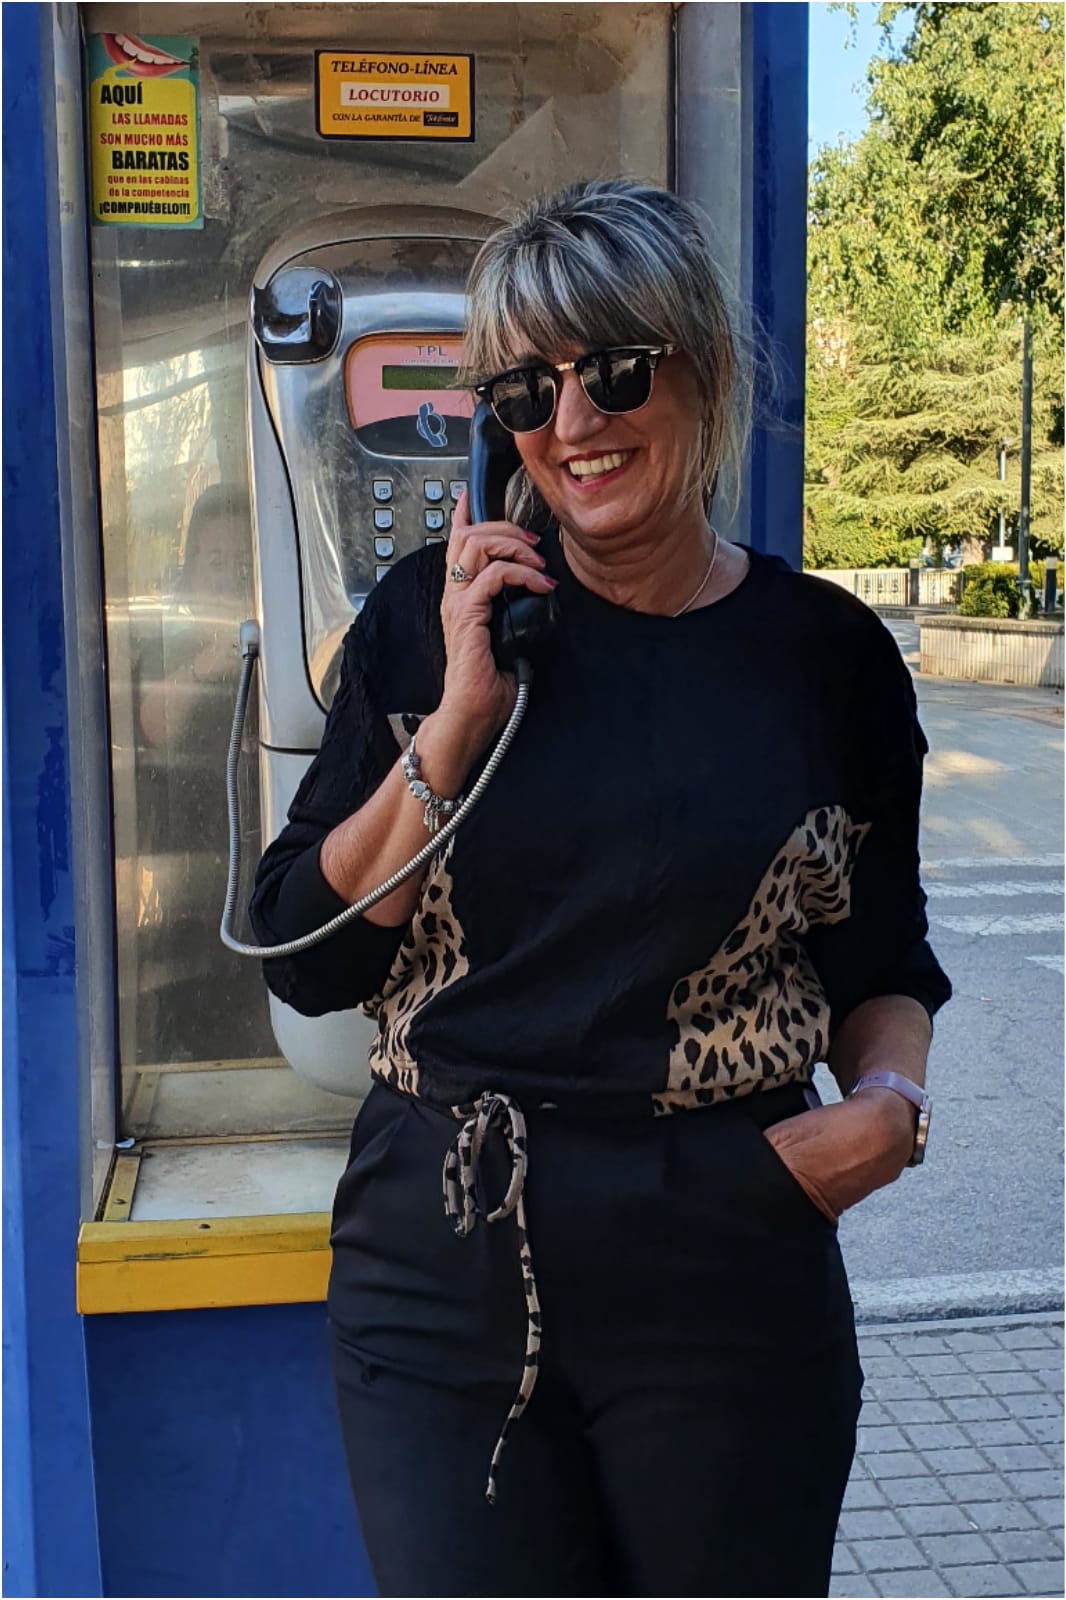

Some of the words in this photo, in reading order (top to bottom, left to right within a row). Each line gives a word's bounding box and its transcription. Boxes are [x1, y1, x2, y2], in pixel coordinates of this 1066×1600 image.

[331, 59, 458, 75] TELÉFONO-LÍNEA
[100, 82, 143, 106] AQUÍ
[349, 89, 440, 102] LOCUTORIO
[112, 113, 131, 125] LAS
[134, 113, 188, 126] LLAMADAS
[332, 113, 350, 121] CON
[364, 113, 407, 122] GARANTÍA
[100, 133, 122, 145] SON
[125, 134, 162, 145] MUCHO
[166, 132, 188, 146] MÁS
[112, 151, 189, 171] BARATAS
[107, 176, 124, 185] que
[126, 176, 137, 184] en
[139, 175, 152, 184] las
[155, 175, 189, 185] cabinas
[109, 188, 120, 197] de
[122, 188, 130, 197] la
[132, 188, 189, 199] competencia
[416, 345, 447, 356] TPL
